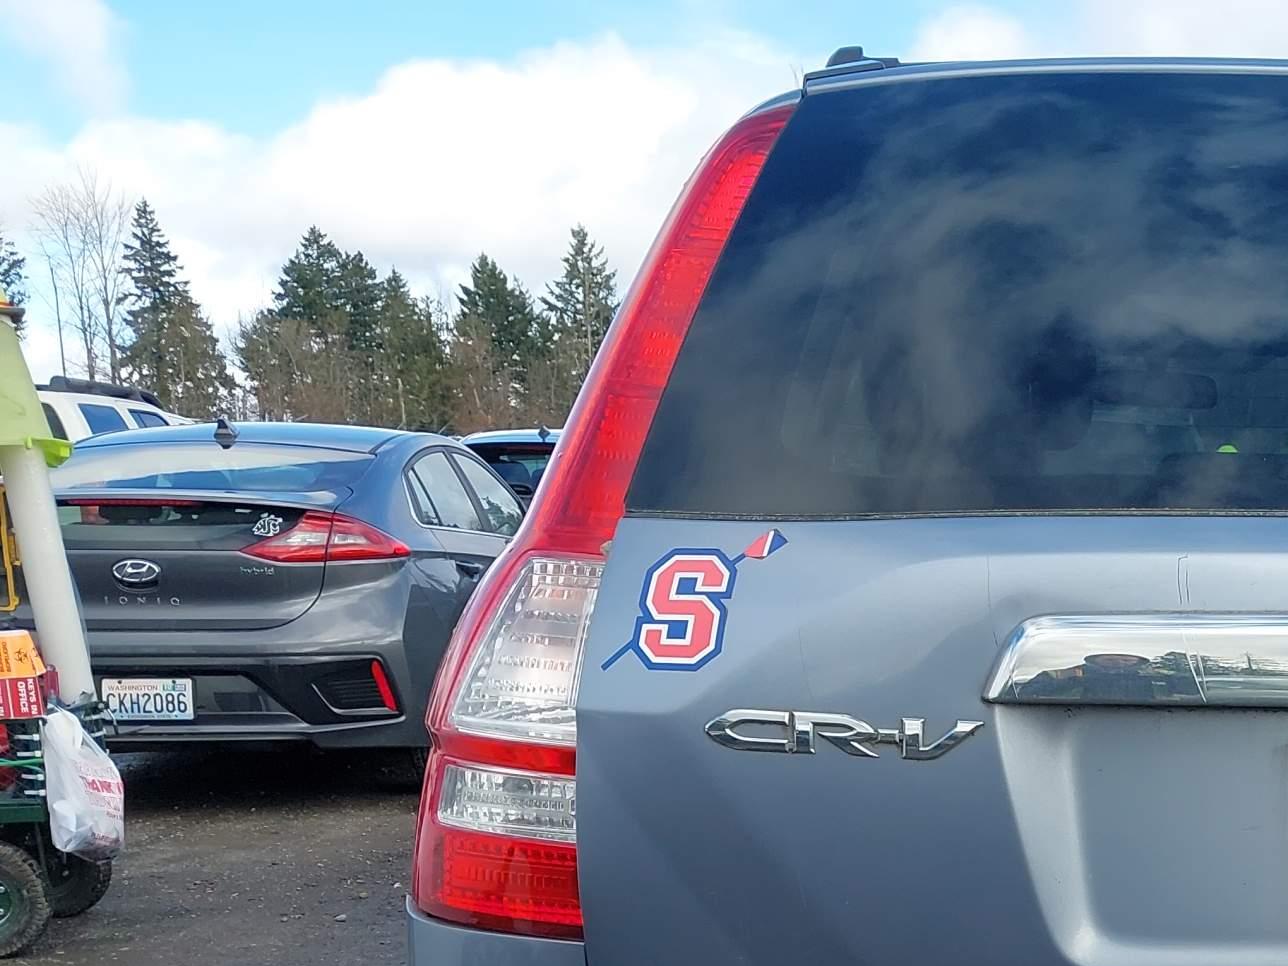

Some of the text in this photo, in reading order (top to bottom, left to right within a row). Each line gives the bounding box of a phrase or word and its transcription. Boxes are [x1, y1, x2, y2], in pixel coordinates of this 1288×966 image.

[104, 596, 180, 606] IONIQ
[17, 681, 29, 713] OFFICE
[107, 684, 158, 692] WASHINGTON
[106, 692, 188, 714] CKH2086
[704, 708, 985, 761] CR-V
